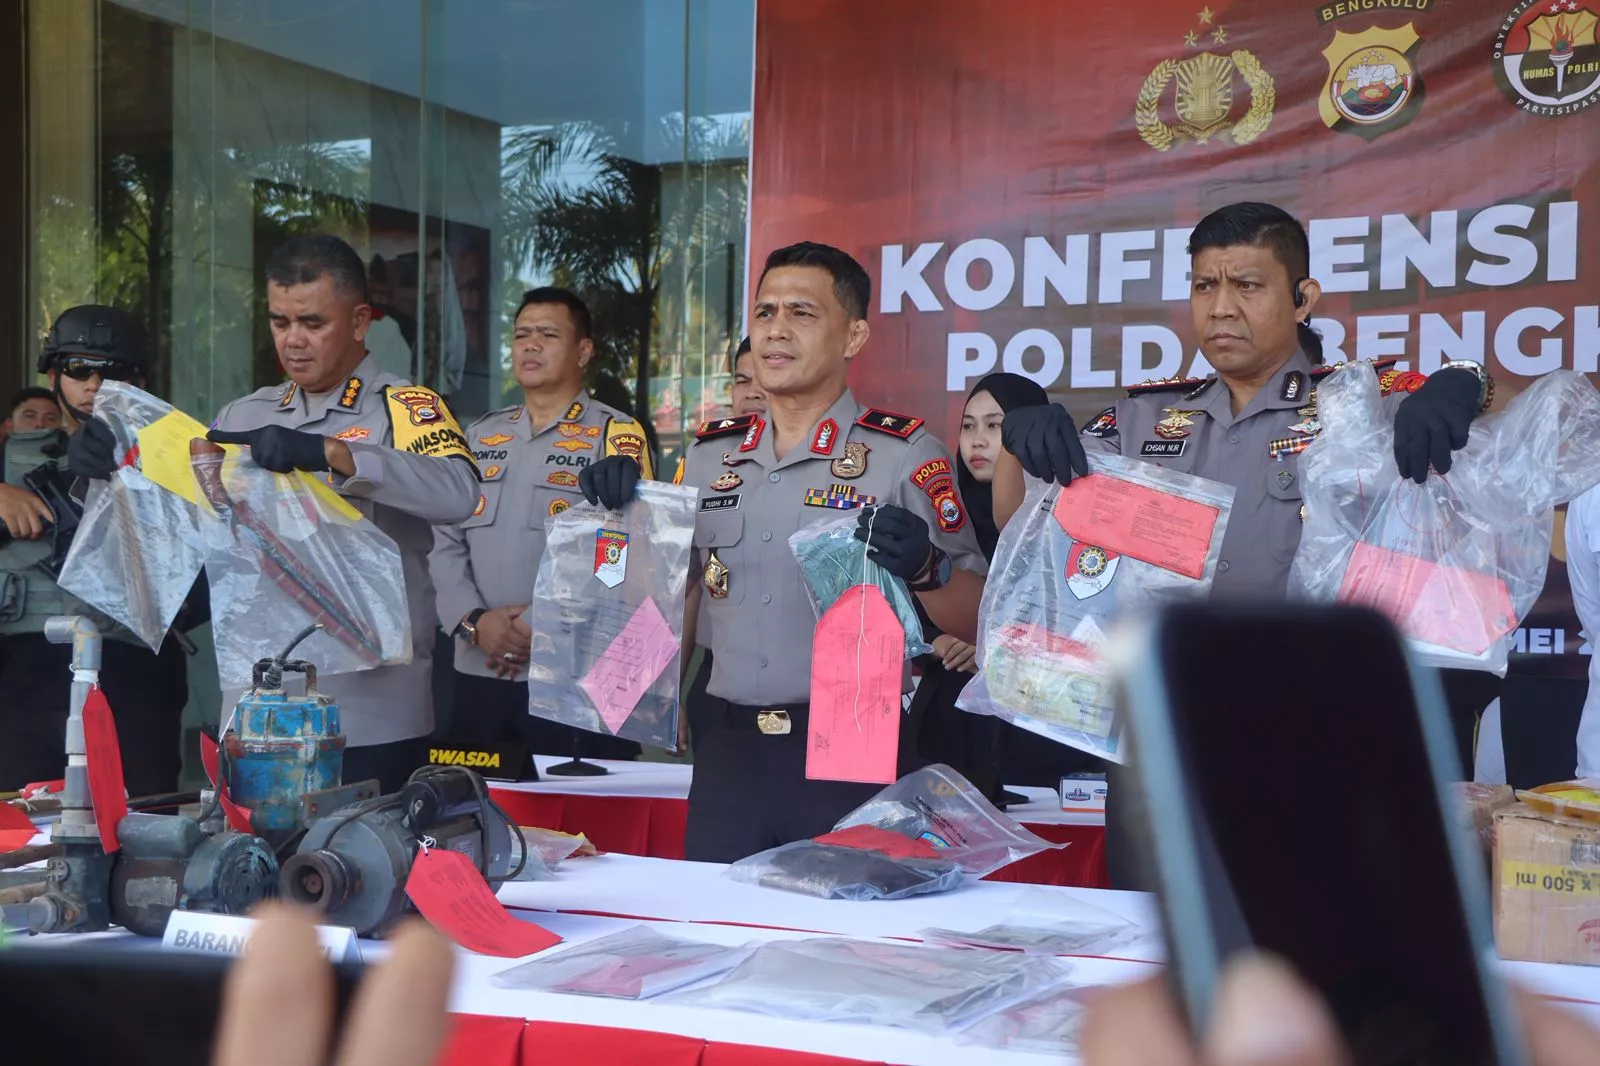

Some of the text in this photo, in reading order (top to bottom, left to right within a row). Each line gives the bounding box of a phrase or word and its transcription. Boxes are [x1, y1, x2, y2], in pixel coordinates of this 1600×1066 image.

[1493, 0, 1534, 59] OBYEKTI
[1523, 62, 1599, 80] HUMAS POLRI
[880, 201, 1578, 314] KONFEENSI
[615, 436, 641, 446] POLDA
[1145, 444, 1180, 452] ICHSAN NUR
[545, 454, 592, 468] POLRI
[915, 461, 946, 484] POLDA
[1516, 872, 1537, 886] ml
[1542, 875, 1575, 892] 500
[174, 928, 251, 953] BARAN
